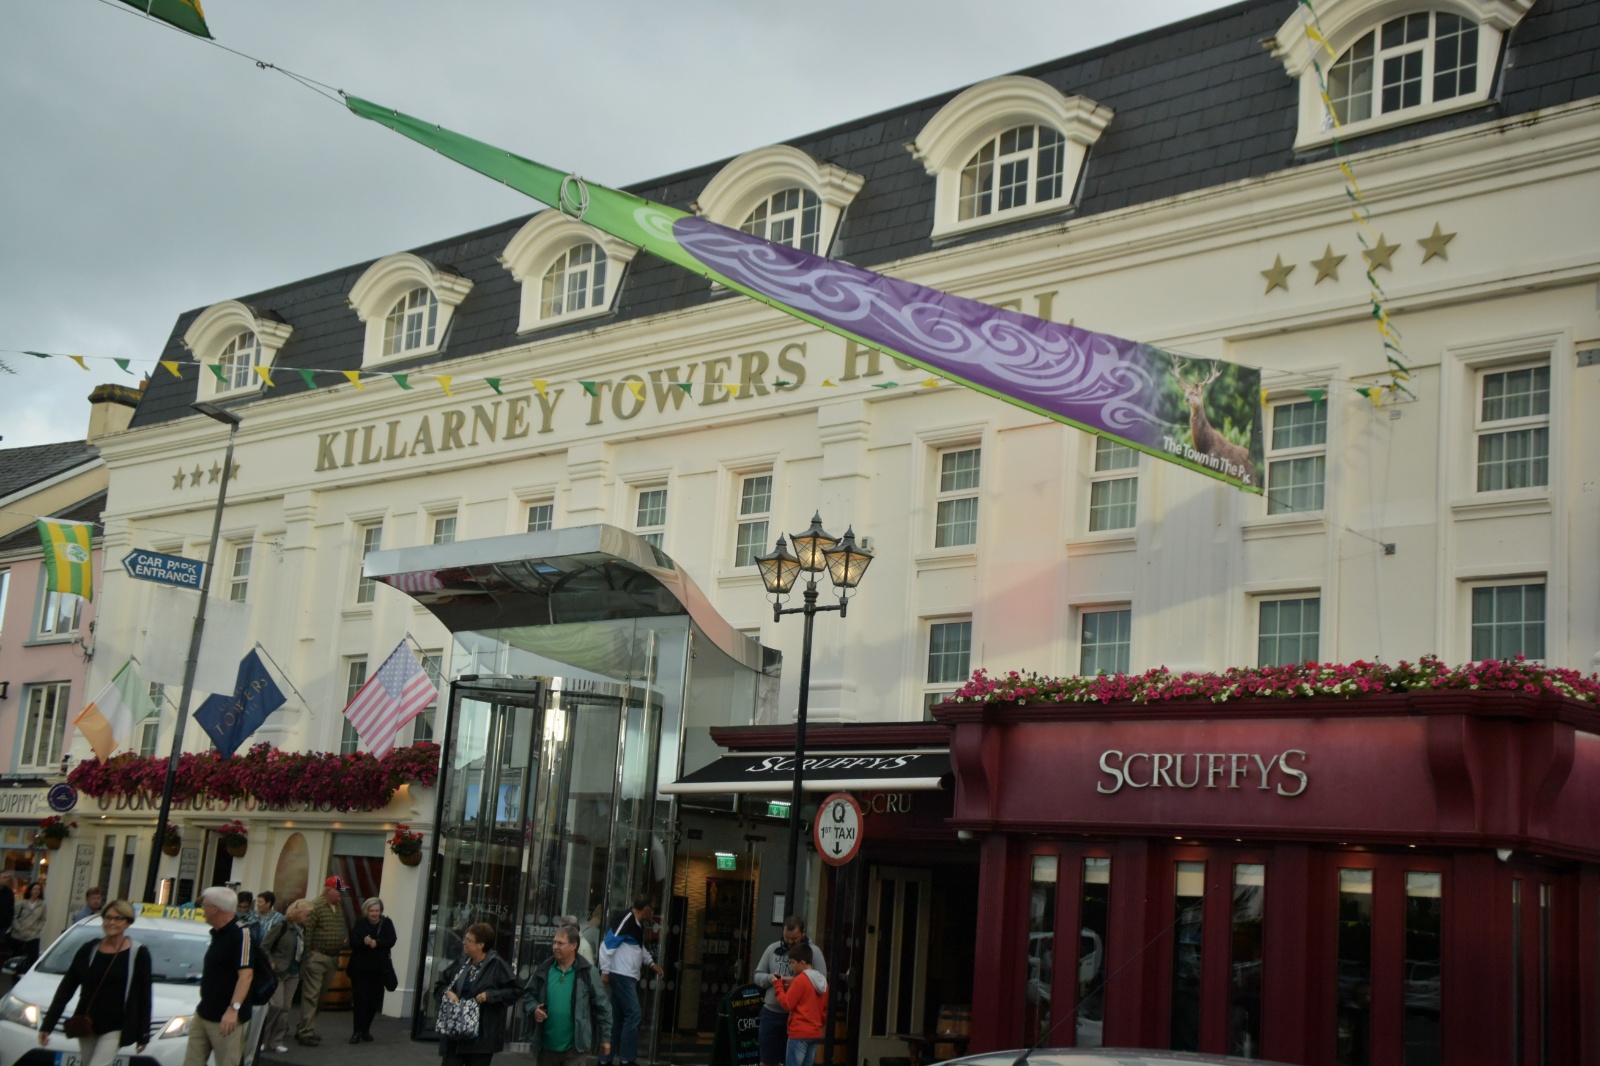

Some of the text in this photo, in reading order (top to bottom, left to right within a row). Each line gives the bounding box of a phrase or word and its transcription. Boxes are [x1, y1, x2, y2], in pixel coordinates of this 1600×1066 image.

[313, 341, 809, 473] KILLARNEY TOWERS
[1163, 436, 1182, 455] The
[1182, 444, 1209, 465] Town
[1209, 453, 1219, 469] in
[1220, 457, 1237, 476] The
[138, 555, 197, 574] CAR PARK
[135, 565, 197, 585] ENTRANCE
[745, 754, 921, 773] SCRUFFYS
[1096, 748, 1308, 797] SCRUFFYS
[0, 793, 37, 813] DIPITY
[832, 802, 845, 823] Q
[820, 826, 855, 840] 1ST TAXI
[165, 906, 195, 920] TAXI
[455, 901, 509, 915] TOWERS
[737, 1017, 761, 1032] CRAIC
